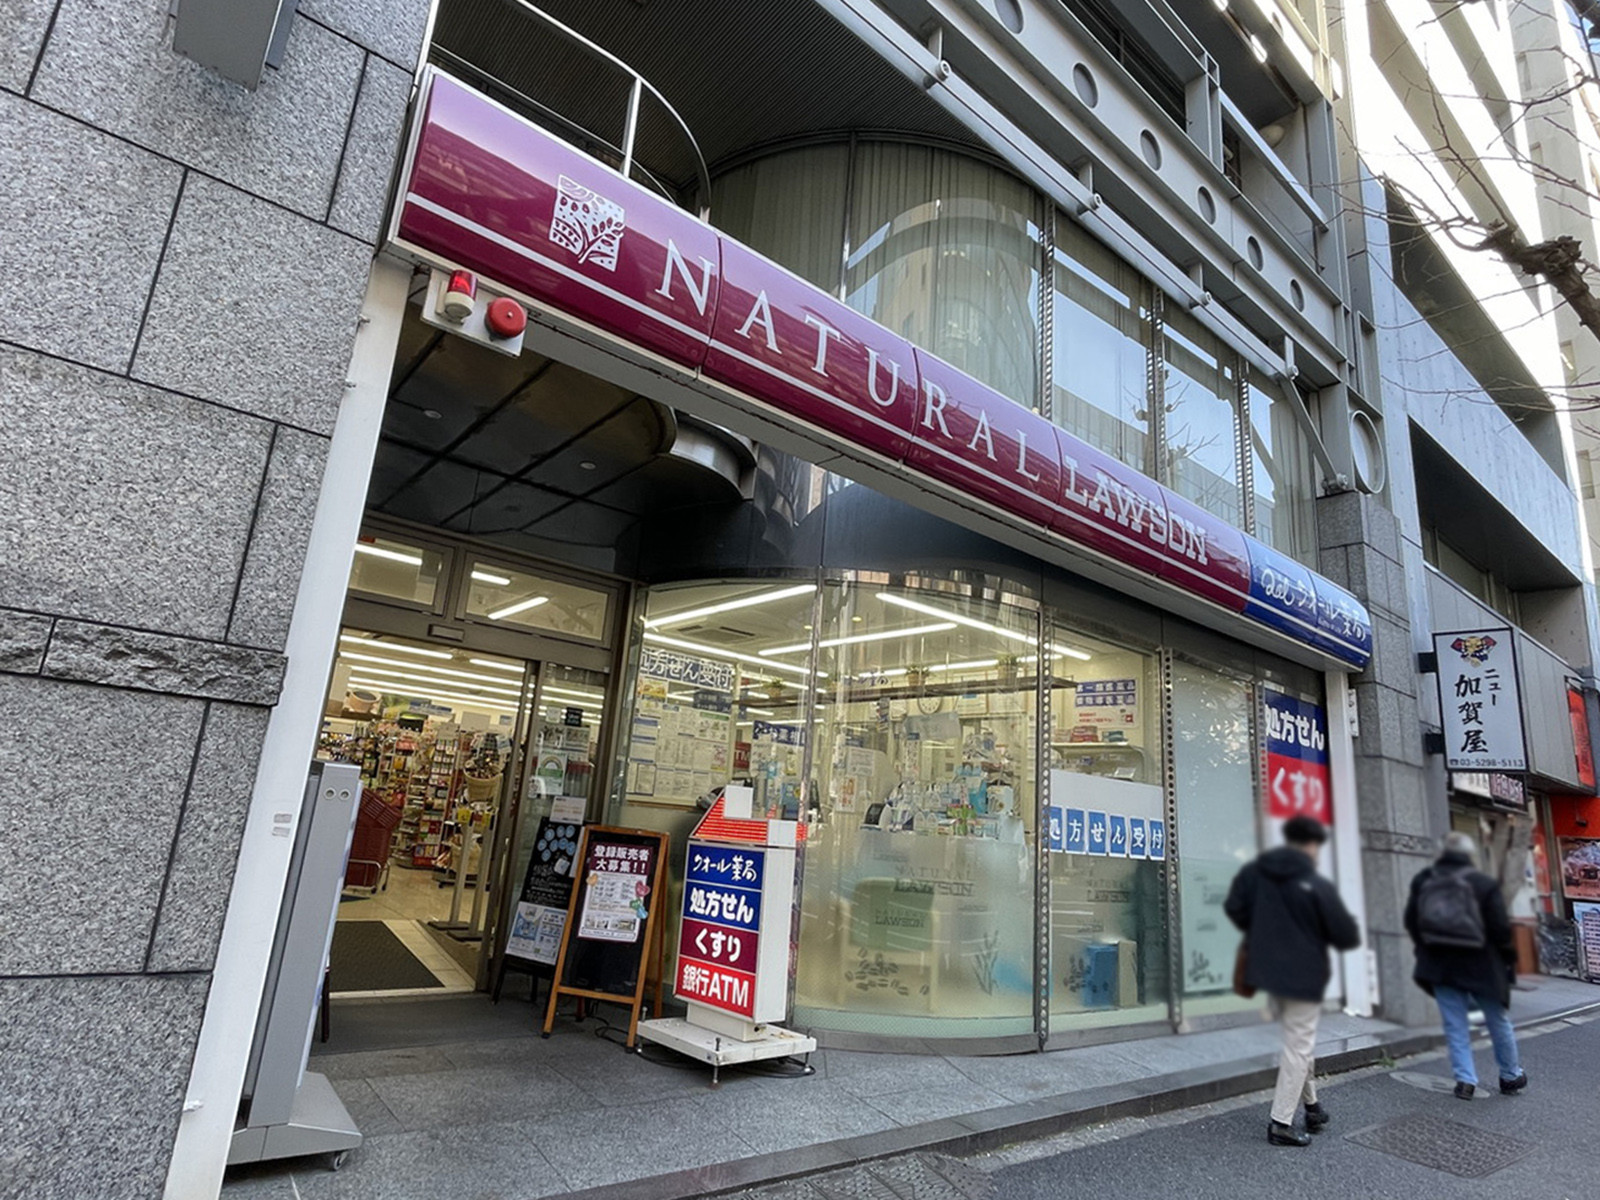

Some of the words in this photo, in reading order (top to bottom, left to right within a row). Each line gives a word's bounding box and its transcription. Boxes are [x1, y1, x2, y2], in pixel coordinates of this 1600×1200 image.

[655, 238, 1040, 482] NATURAL
[1064, 454, 1209, 566] LAWSON
[1484, 668, 1502, 706] ニュー
[1265, 704, 1325, 751] 処方せん
[1454, 674, 1489, 754] 加賀屋
[1271, 767, 1325, 813] くすり
[693, 854, 758, 882] クオール薬局
[689, 887, 754, 924] 処方せん
[695, 928, 742, 962] くすり
[682, 964, 750, 1008] 銀行ATM
